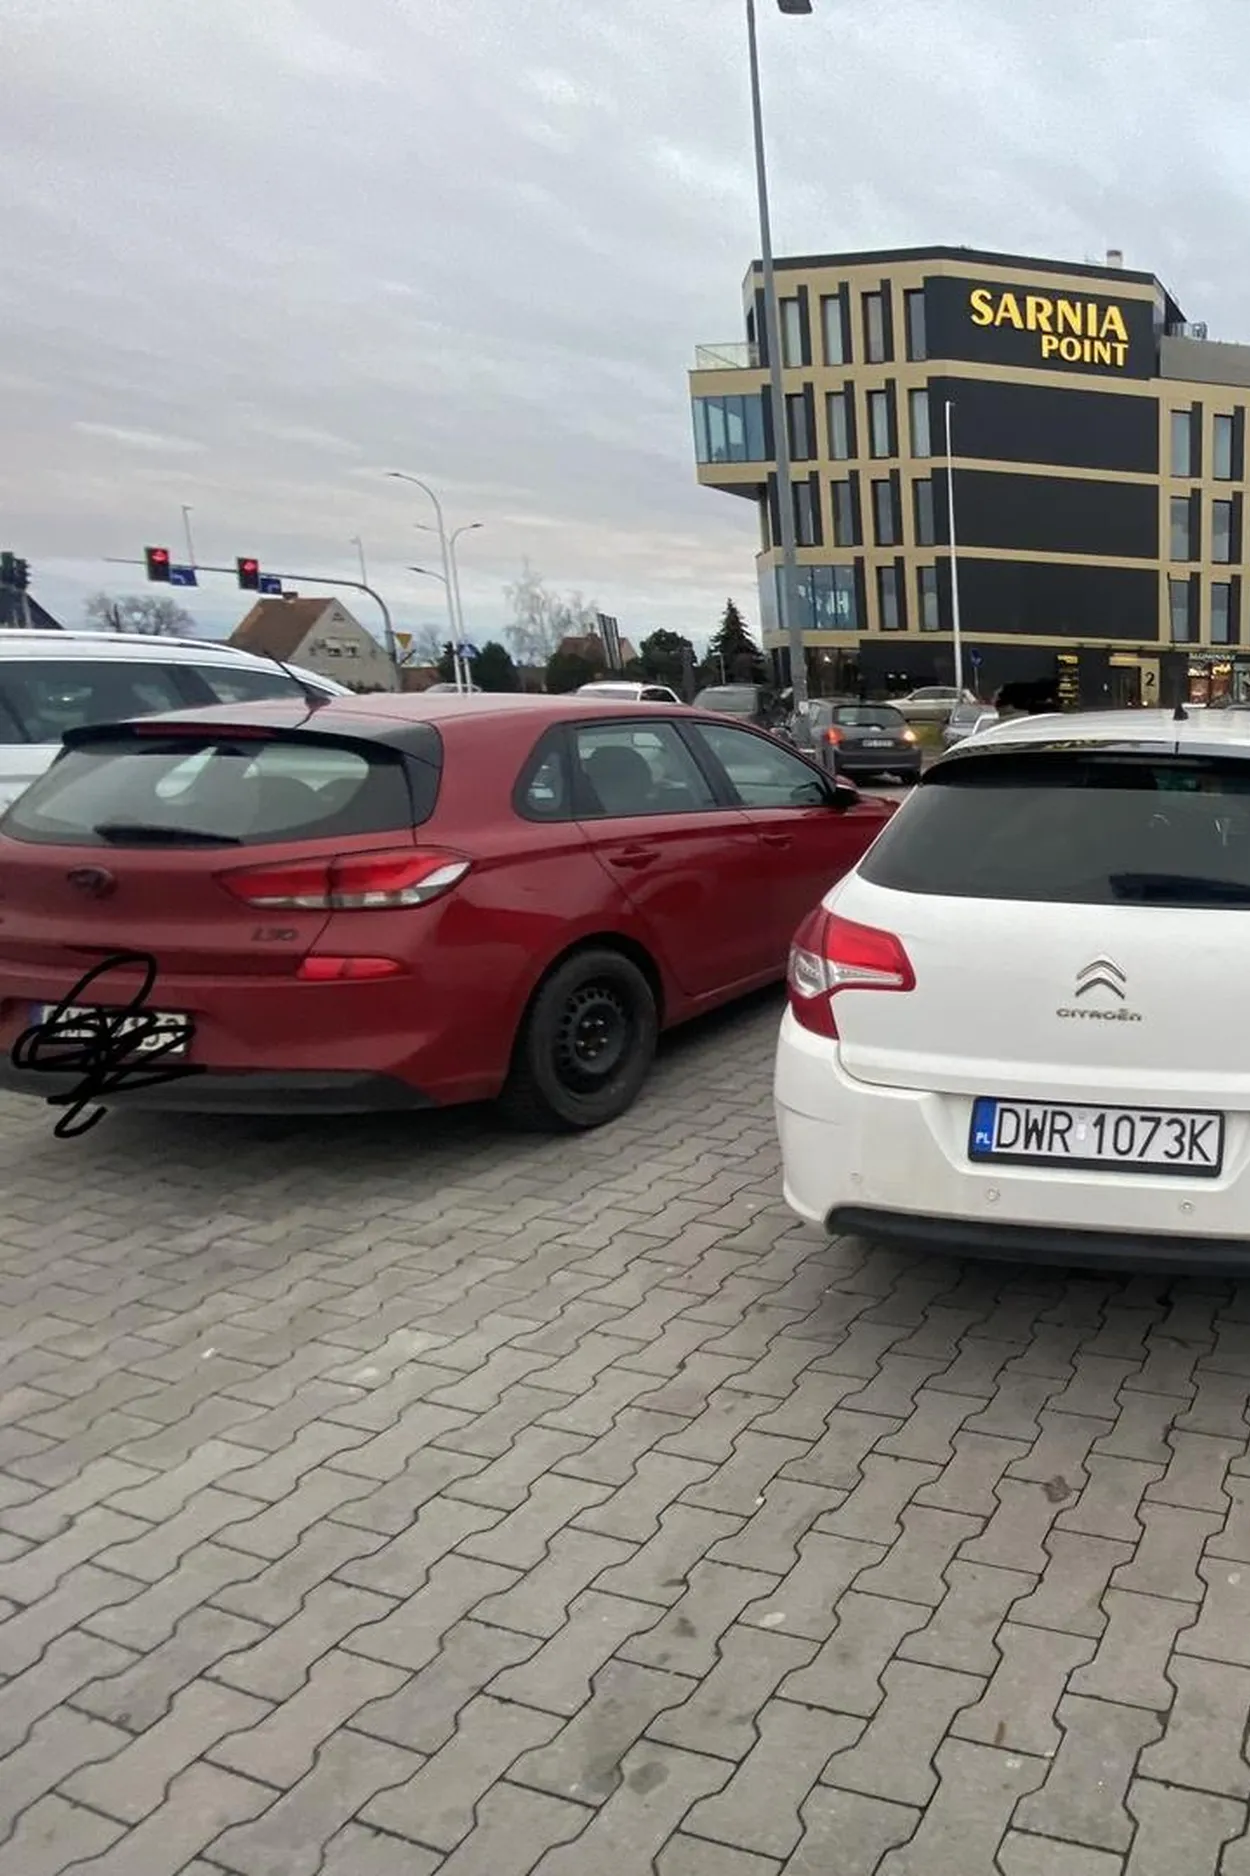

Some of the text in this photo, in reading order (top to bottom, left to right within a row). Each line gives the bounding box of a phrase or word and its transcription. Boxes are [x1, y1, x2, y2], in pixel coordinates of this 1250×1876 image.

[970, 289, 1128, 341] SARNIA
[1041, 335, 1129, 366] POINT
[1145, 671, 1154, 686] 2
[975, 1131, 991, 1145] PL
[996, 1107, 1213, 1162] DWR 1073K
